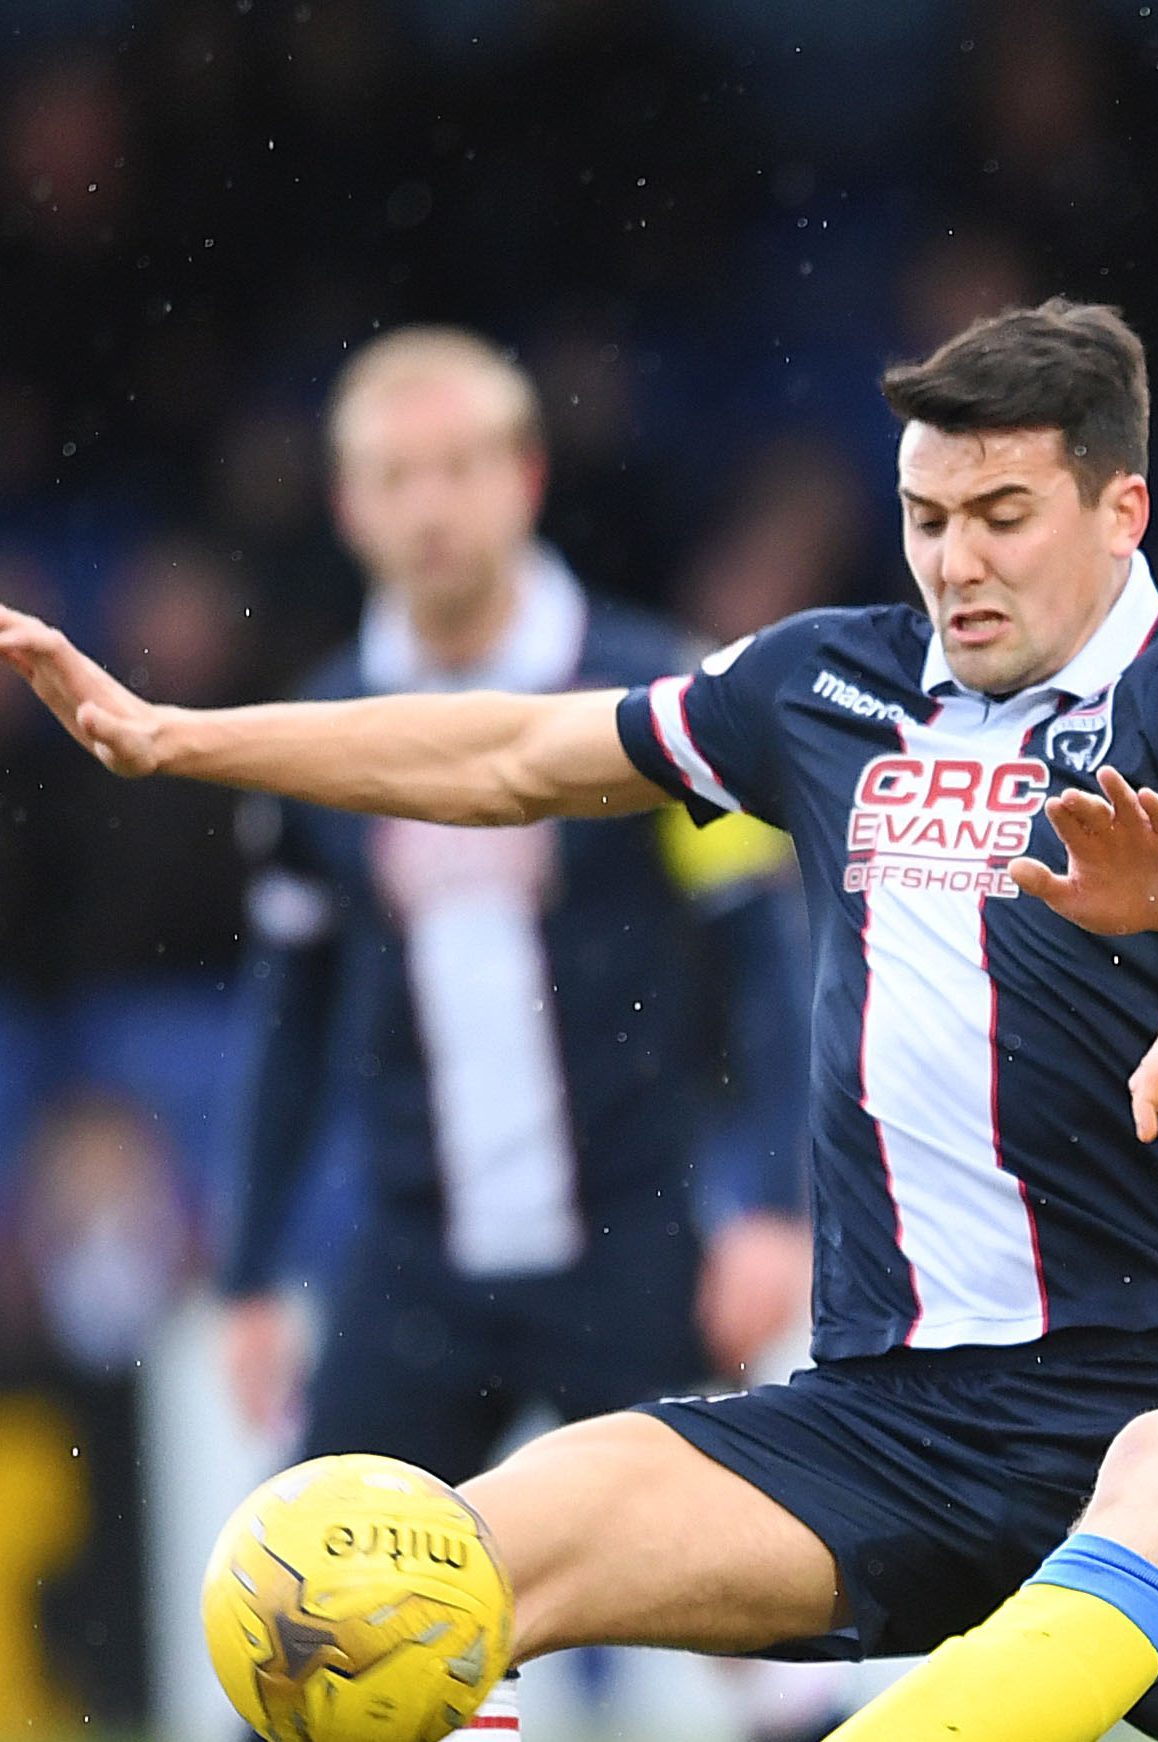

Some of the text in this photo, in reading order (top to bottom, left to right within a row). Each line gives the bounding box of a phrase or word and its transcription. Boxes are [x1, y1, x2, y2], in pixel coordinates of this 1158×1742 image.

[860, 758, 1047, 814] CRC
[851, 812, 1029, 852] EVANS
[845, 865, 1018, 897] OFFSHORE
[324, 1523, 468, 1570] mitre
